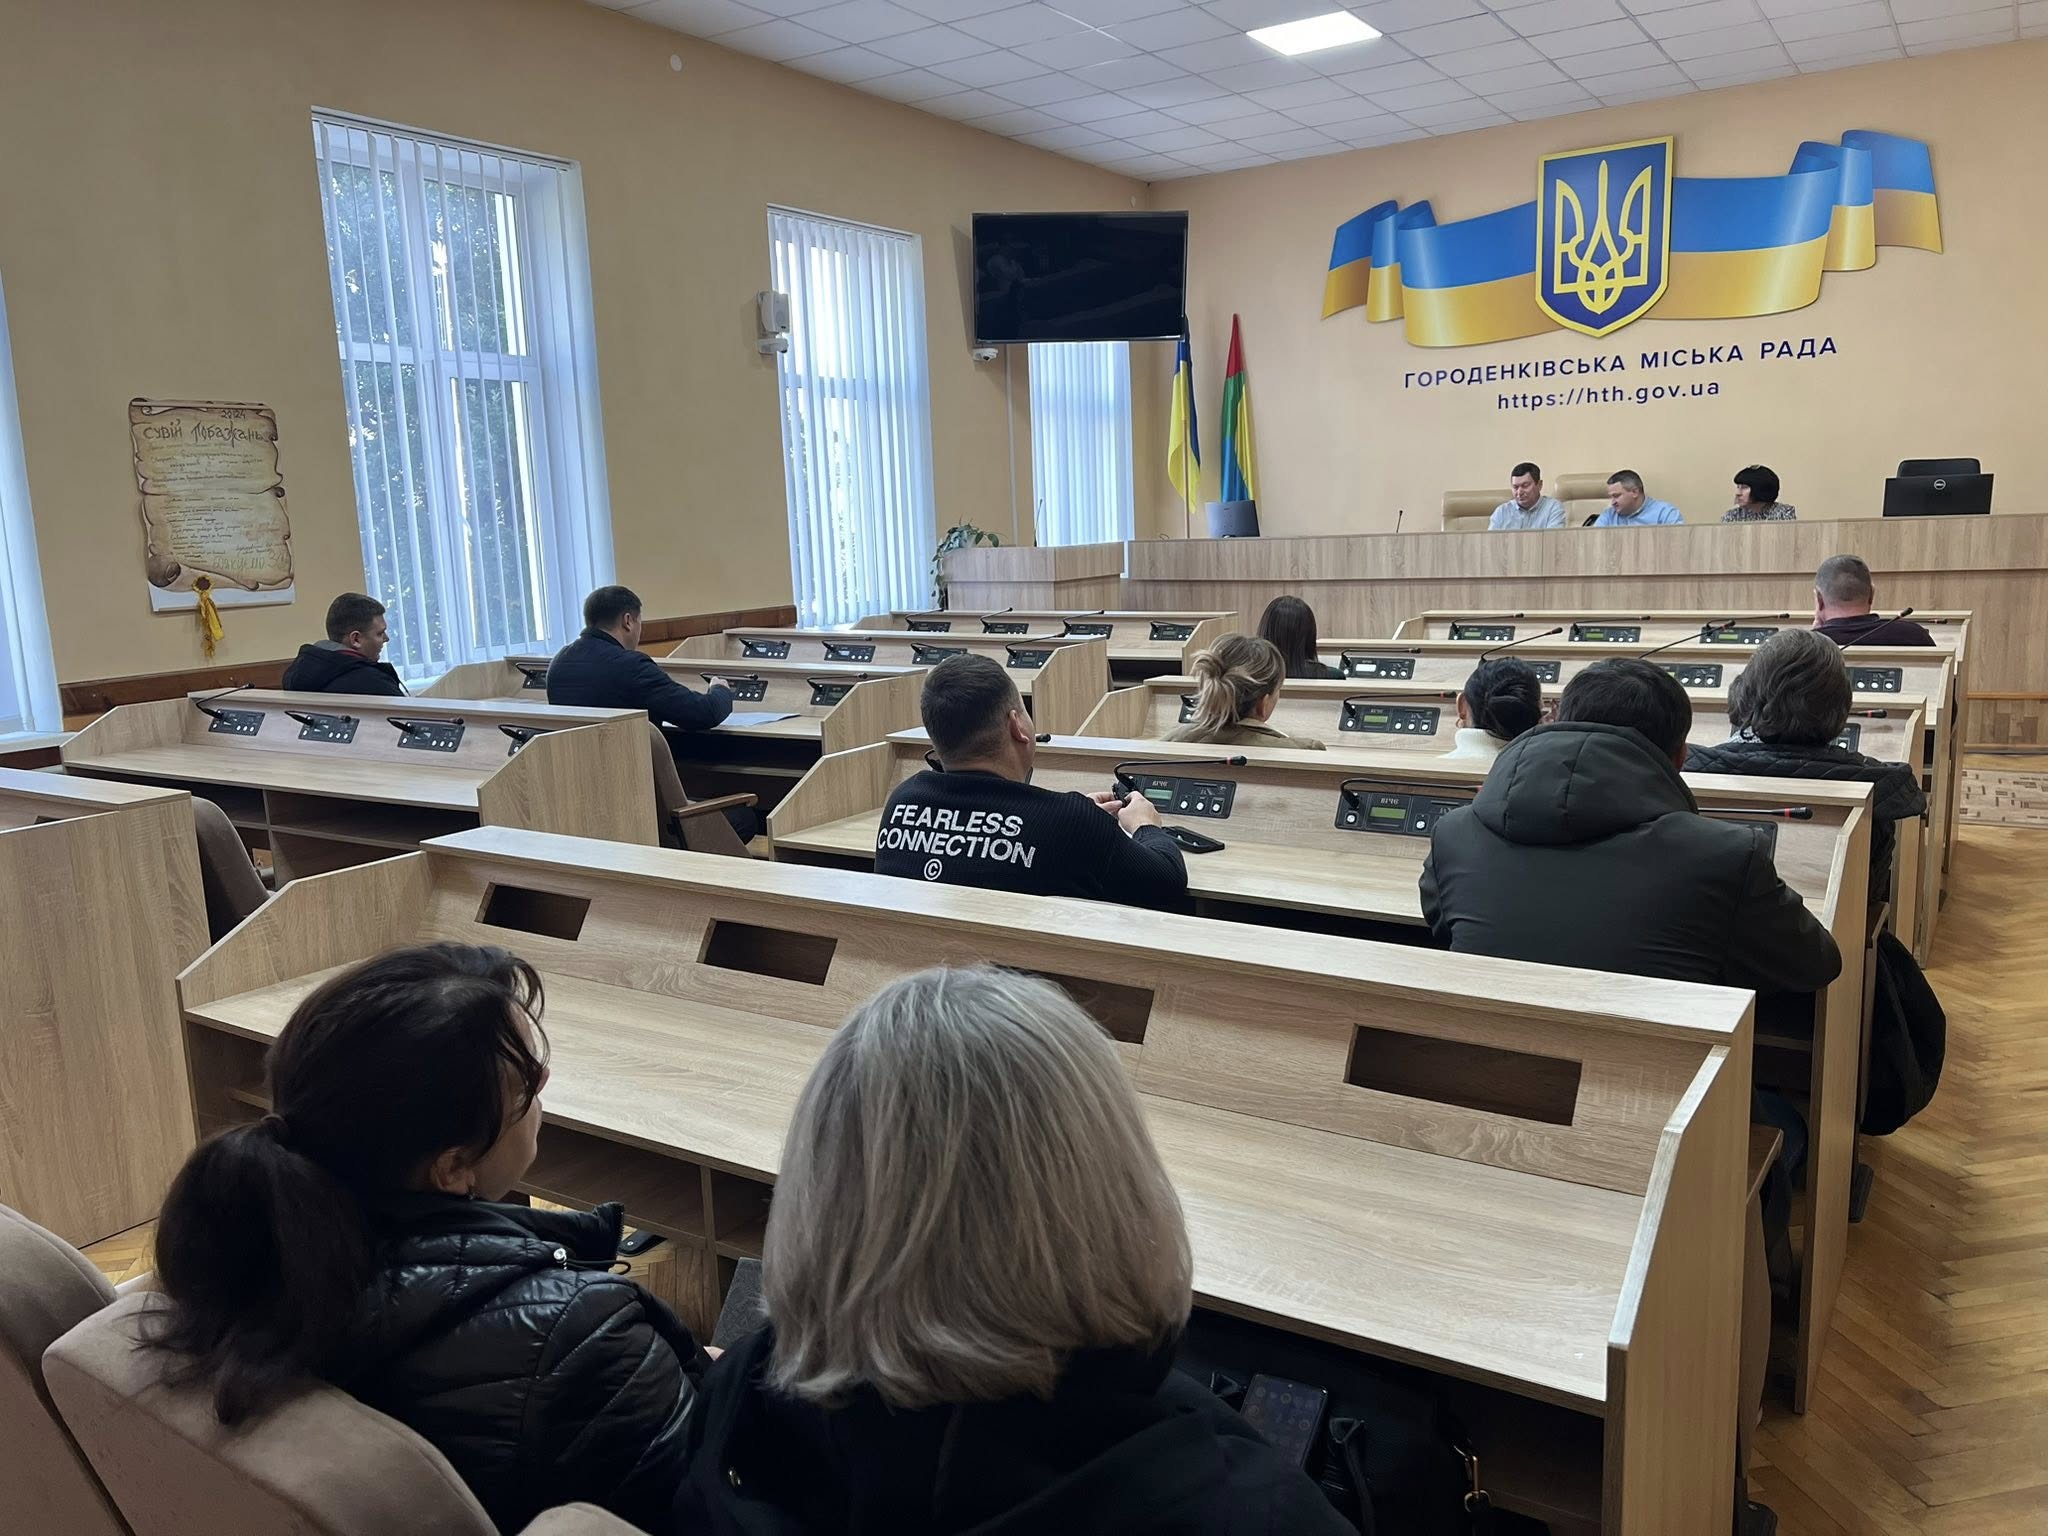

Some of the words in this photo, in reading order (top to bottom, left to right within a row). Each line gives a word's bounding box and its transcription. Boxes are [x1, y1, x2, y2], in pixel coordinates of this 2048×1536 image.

[1404, 355, 1626, 389] ГОРОДЕНКІВСЬКА
[1640, 345, 1744, 370] МІСЬКА
[1760, 337, 1838, 360] РАДА
[1497, 381, 1720, 410] https://hth.gov.ua
[890, 804, 1024, 837] FEARLESS
[877, 827, 1037, 869] CONNECTION
